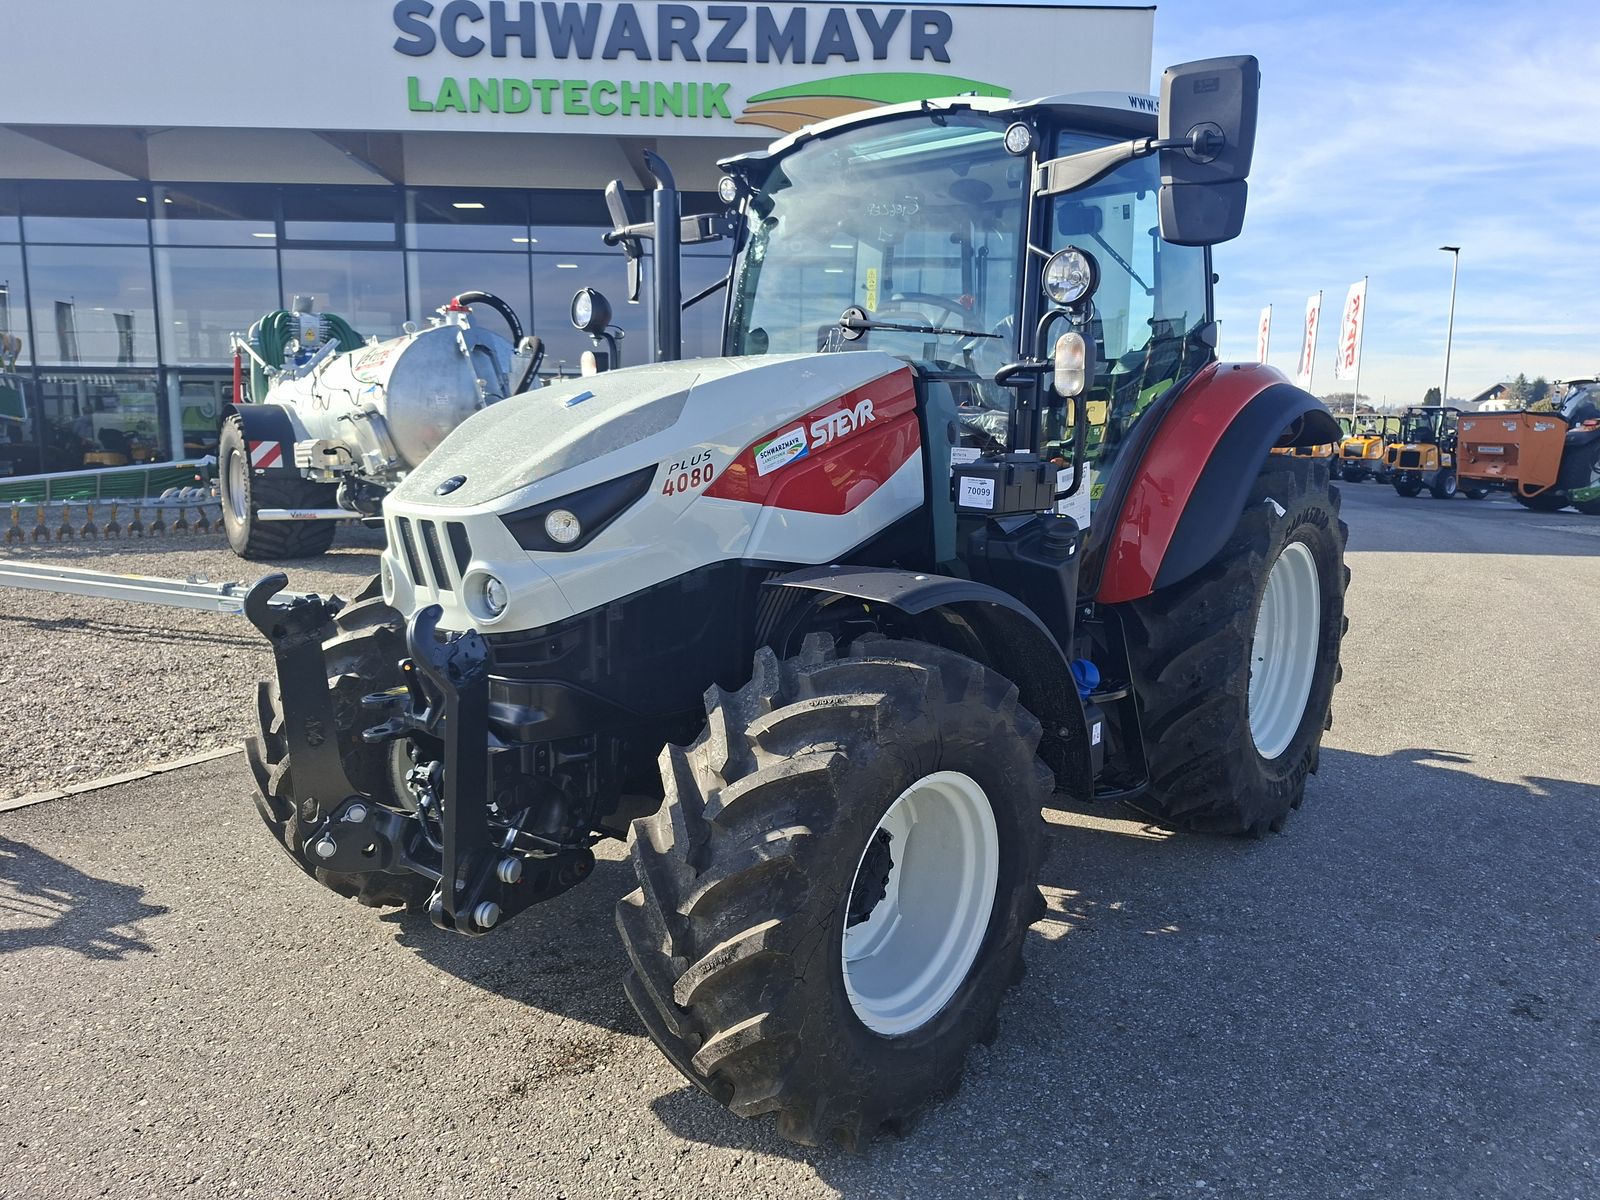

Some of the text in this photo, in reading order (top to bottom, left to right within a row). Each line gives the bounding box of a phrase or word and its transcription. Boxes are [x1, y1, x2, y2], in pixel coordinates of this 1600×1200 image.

[393, 0, 953, 65] SCHWARZMAYR
[407, 76, 732, 118] LANDTECHNIK
[810, 399, 876, 450] STEYR
[669, 449, 712, 476] PLUS
[760, 437, 799, 459] SCHWARZMAYR
[662, 463, 714, 497] 4080
[967, 486, 991, 497] 70099
